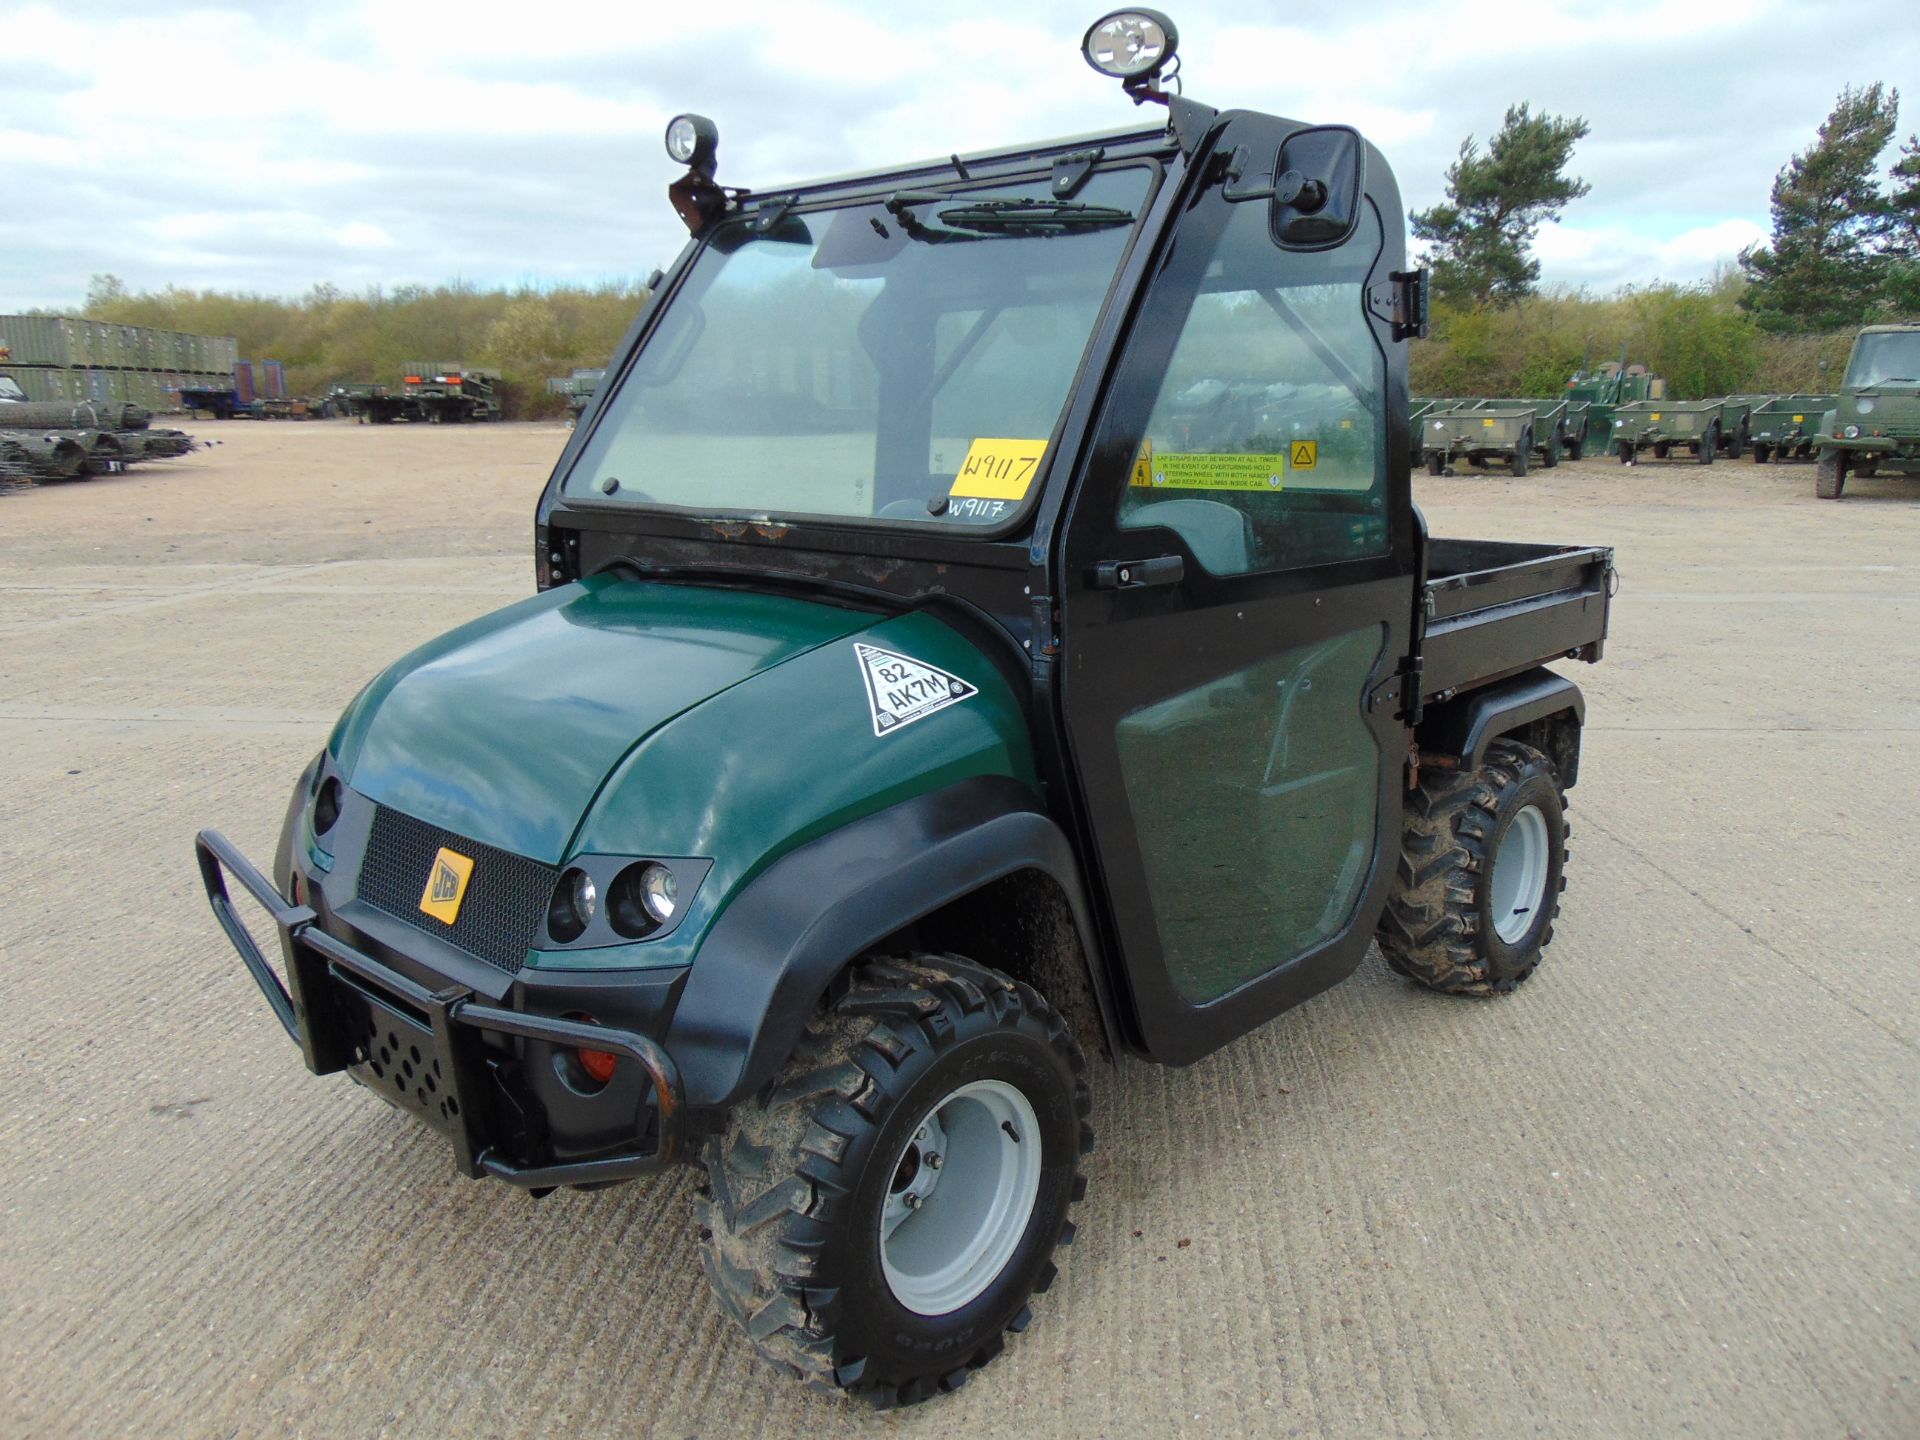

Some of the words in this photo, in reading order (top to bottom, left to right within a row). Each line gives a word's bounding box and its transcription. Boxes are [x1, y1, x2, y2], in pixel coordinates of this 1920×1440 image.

[963, 455, 1038, 481] W9117
[948, 498, 1005, 517] W9117
[878, 663, 913, 684] 82
[887, 674, 946, 711] AK7M
[433, 864, 457, 899] JCB
